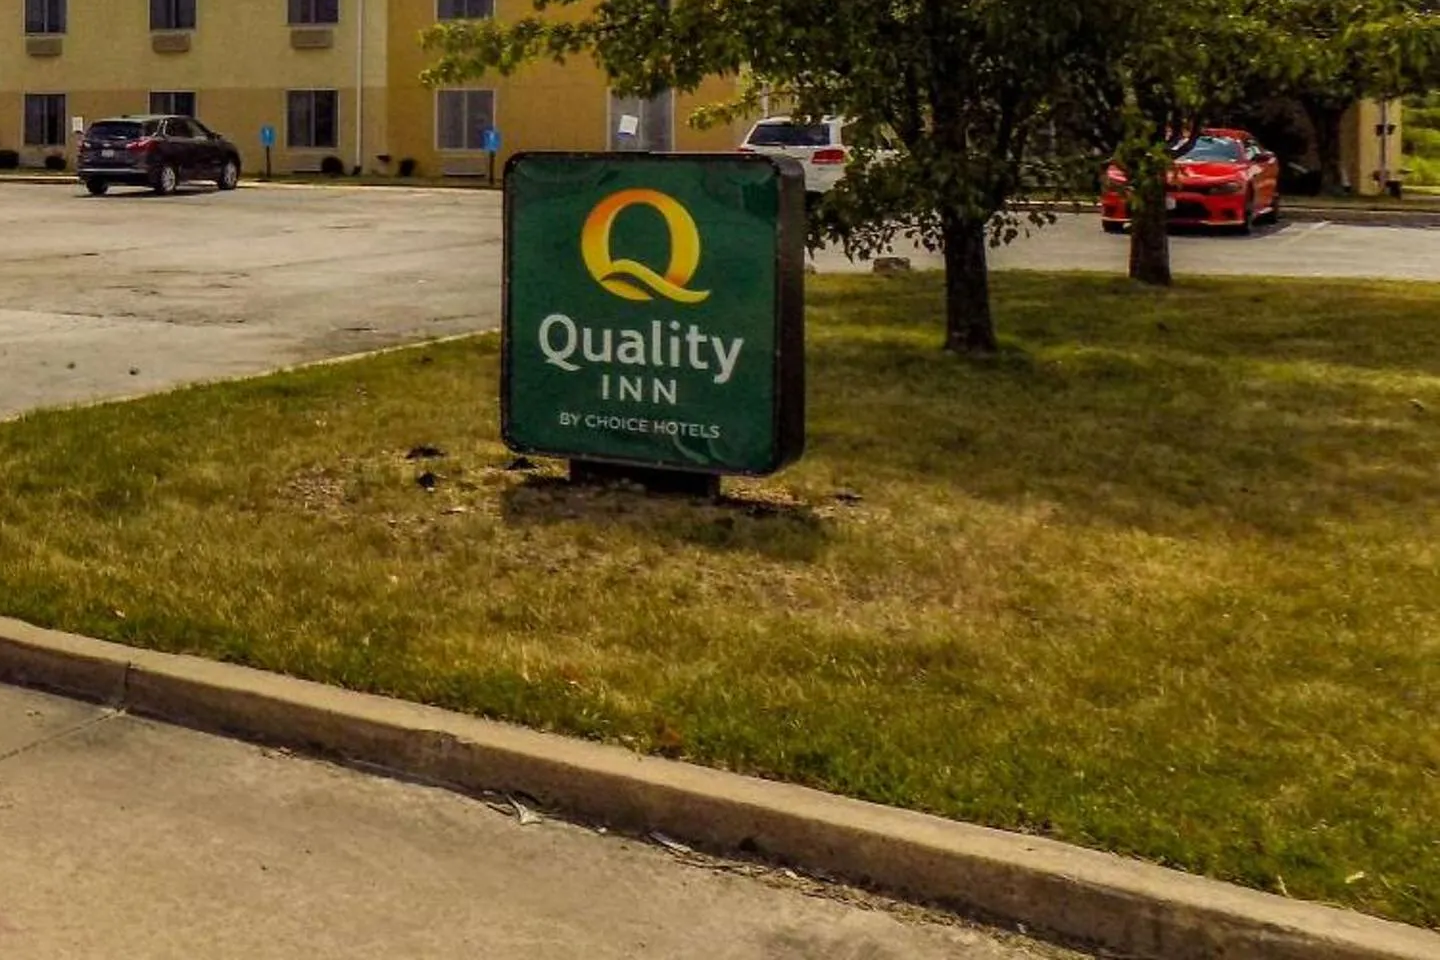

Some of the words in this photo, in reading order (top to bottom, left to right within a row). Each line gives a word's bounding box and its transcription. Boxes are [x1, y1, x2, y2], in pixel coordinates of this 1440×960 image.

[581, 188, 710, 303] Q
[538, 314, 744, 384] Quality
[601, 374, 677, 405] INN
[560, 412, 580, 426] BY
[584, 414, 648, 432] CHOICE
[653, 420, 721, 439] HOTELS
